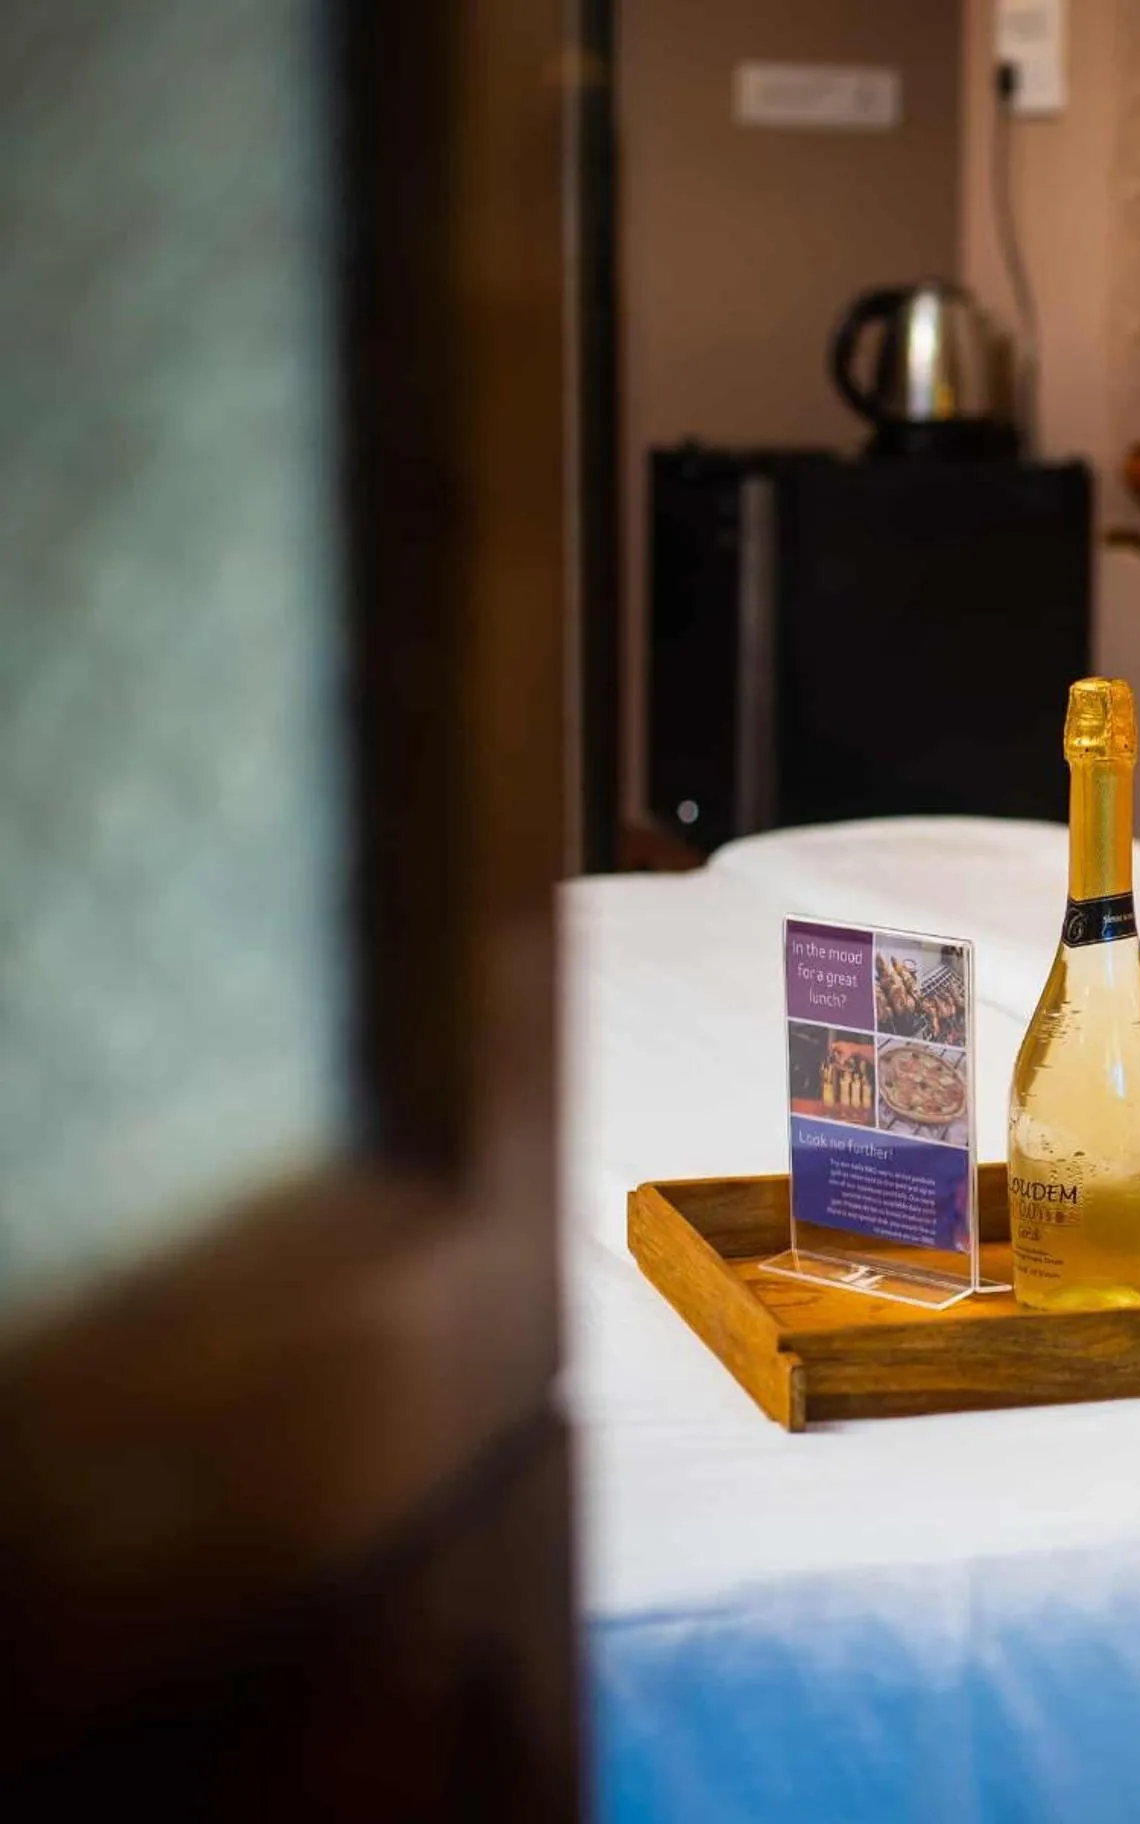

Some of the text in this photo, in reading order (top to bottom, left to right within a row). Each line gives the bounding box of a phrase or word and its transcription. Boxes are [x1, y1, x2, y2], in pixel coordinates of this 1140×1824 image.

[792, 940, 863, 965] In the mood
[797, 963, 857, 988] for a great
[809, 988, 847, 1008] lunch?
[799, 1131, 828, 1148] Look
[830, 1138, 846, 1150] no
[1009, 1177, 1077, 1205] OUDEM
